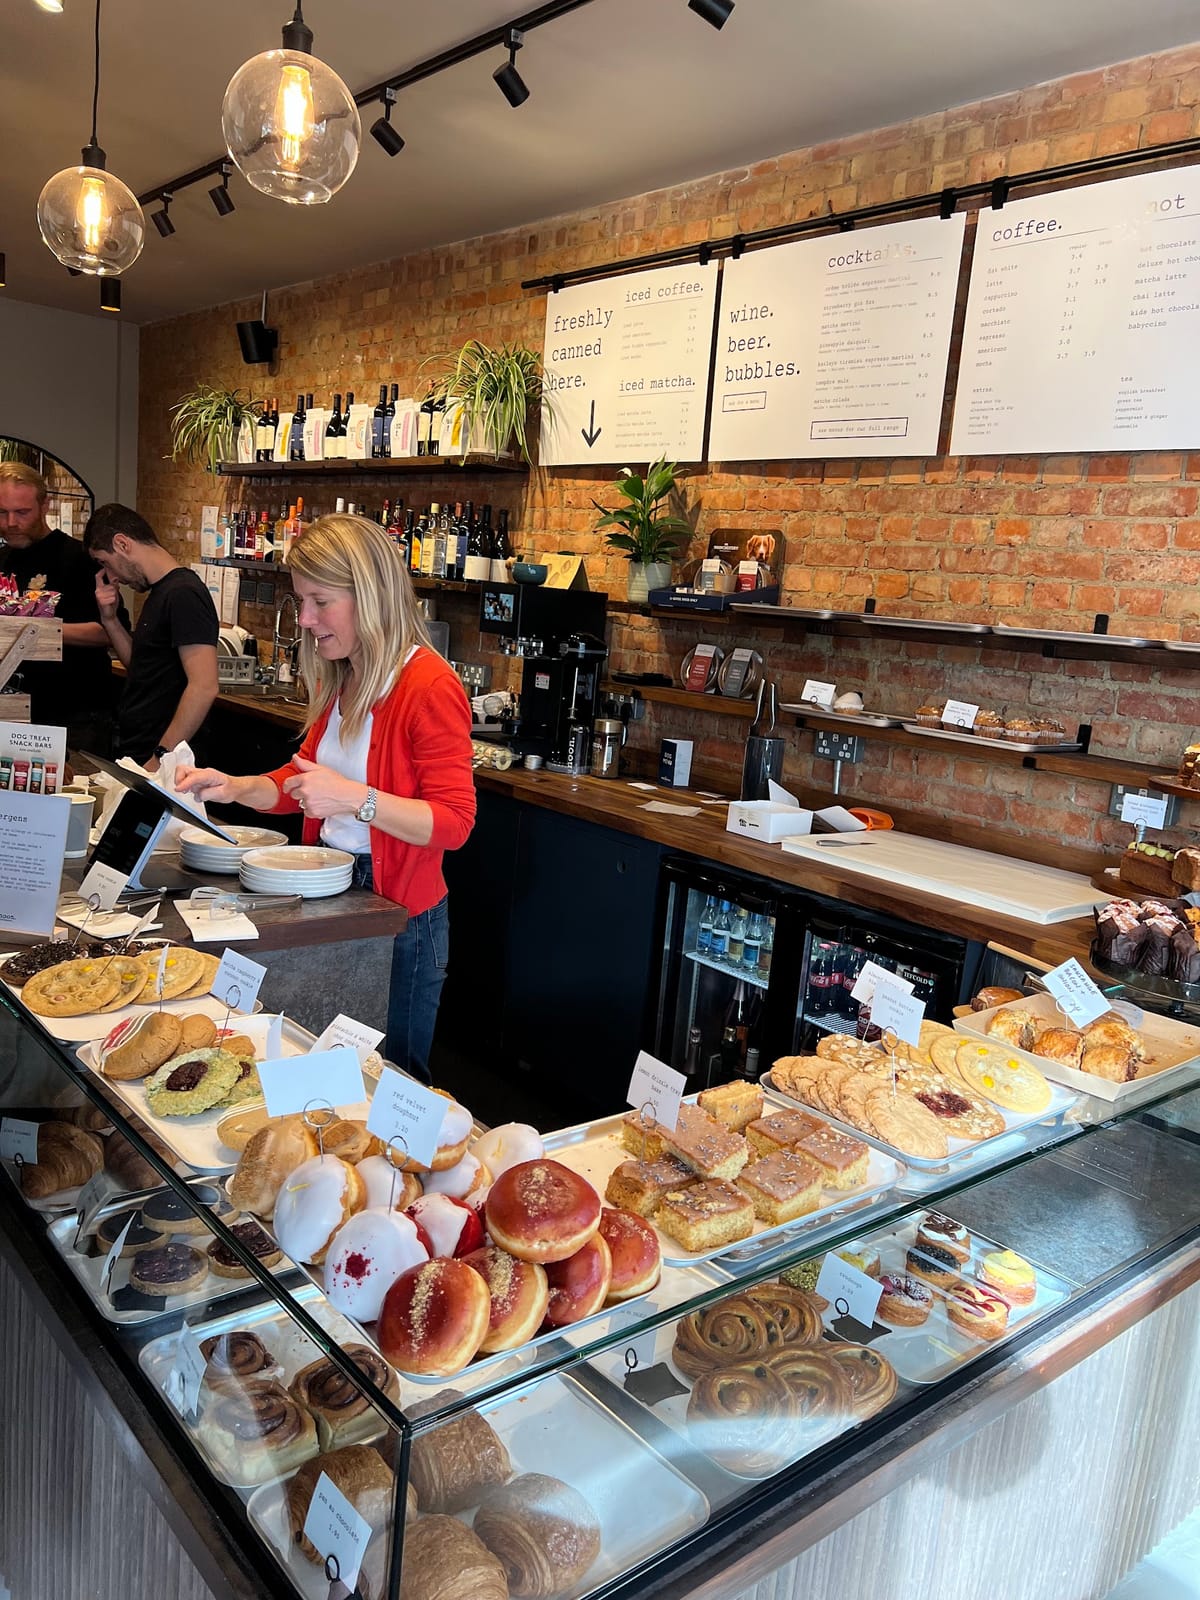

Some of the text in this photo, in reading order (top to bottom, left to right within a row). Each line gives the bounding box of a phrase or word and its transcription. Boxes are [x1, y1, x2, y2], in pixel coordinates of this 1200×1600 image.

[992, 218, 1063, 242] coffee.
[1157, 240, 1196, 251] chocolate
[1137, 259, 1163, 269] deluxe
[1134, 273, 1187, 285] matcha latte
[625, 282, 704, 303] iced coffee.
[1132, 290, 1176, 301] chai latte
[553, 307, 614, 333] freshly
[730, 304, 774, 324] wine.
[1130, 308, 1148, 317] kids
[1128, 320, 1167, 330] babyccino
[552, 338, 602, 362] canned
[728, 334, 771, 353] beer.
[725, 361, 801, 383] bubbles.
[550, 374, 586, 391] here.
[619, 375, 696, 392] iced matcha.
[567, 736, 576, 769] noon.
[903, 971, 928, 985] TEFCOLD
[392, 1091, 427, 1114] red velvet
[392, 1103, 420, 1122] doughnut
